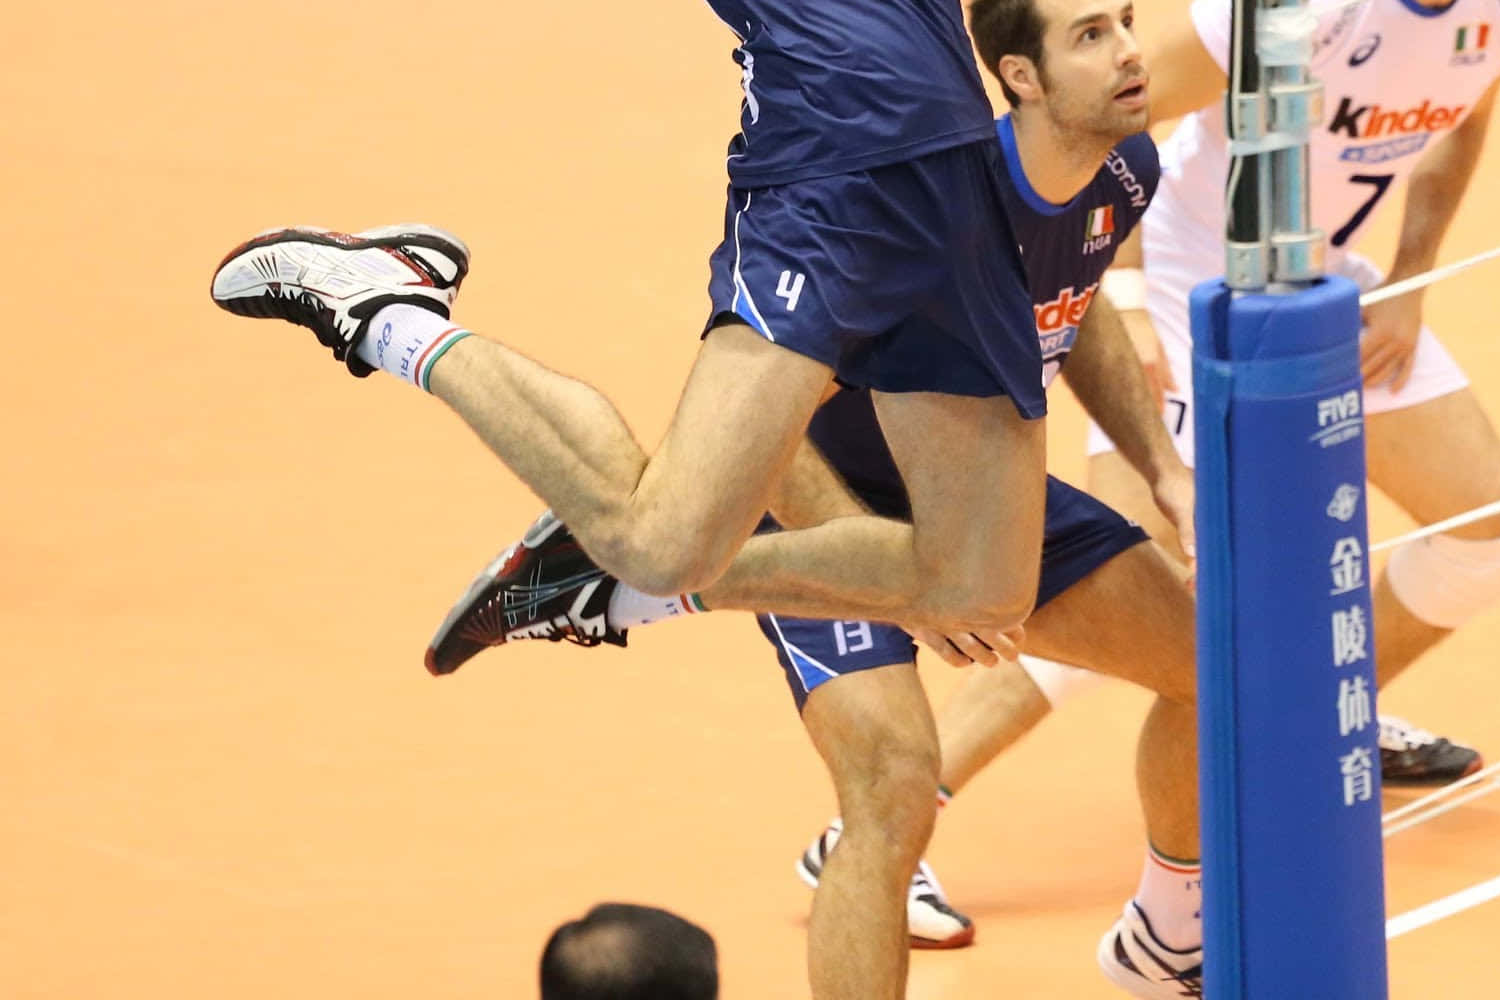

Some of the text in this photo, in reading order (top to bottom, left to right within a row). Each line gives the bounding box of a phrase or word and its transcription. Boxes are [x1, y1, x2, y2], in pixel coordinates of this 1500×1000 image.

[1330, 174, 1394, 247] 7
[776, 270, 805, 312] 4
[1168, 399, 1186, 435] 7
[833, 620, 873, 656] 13
